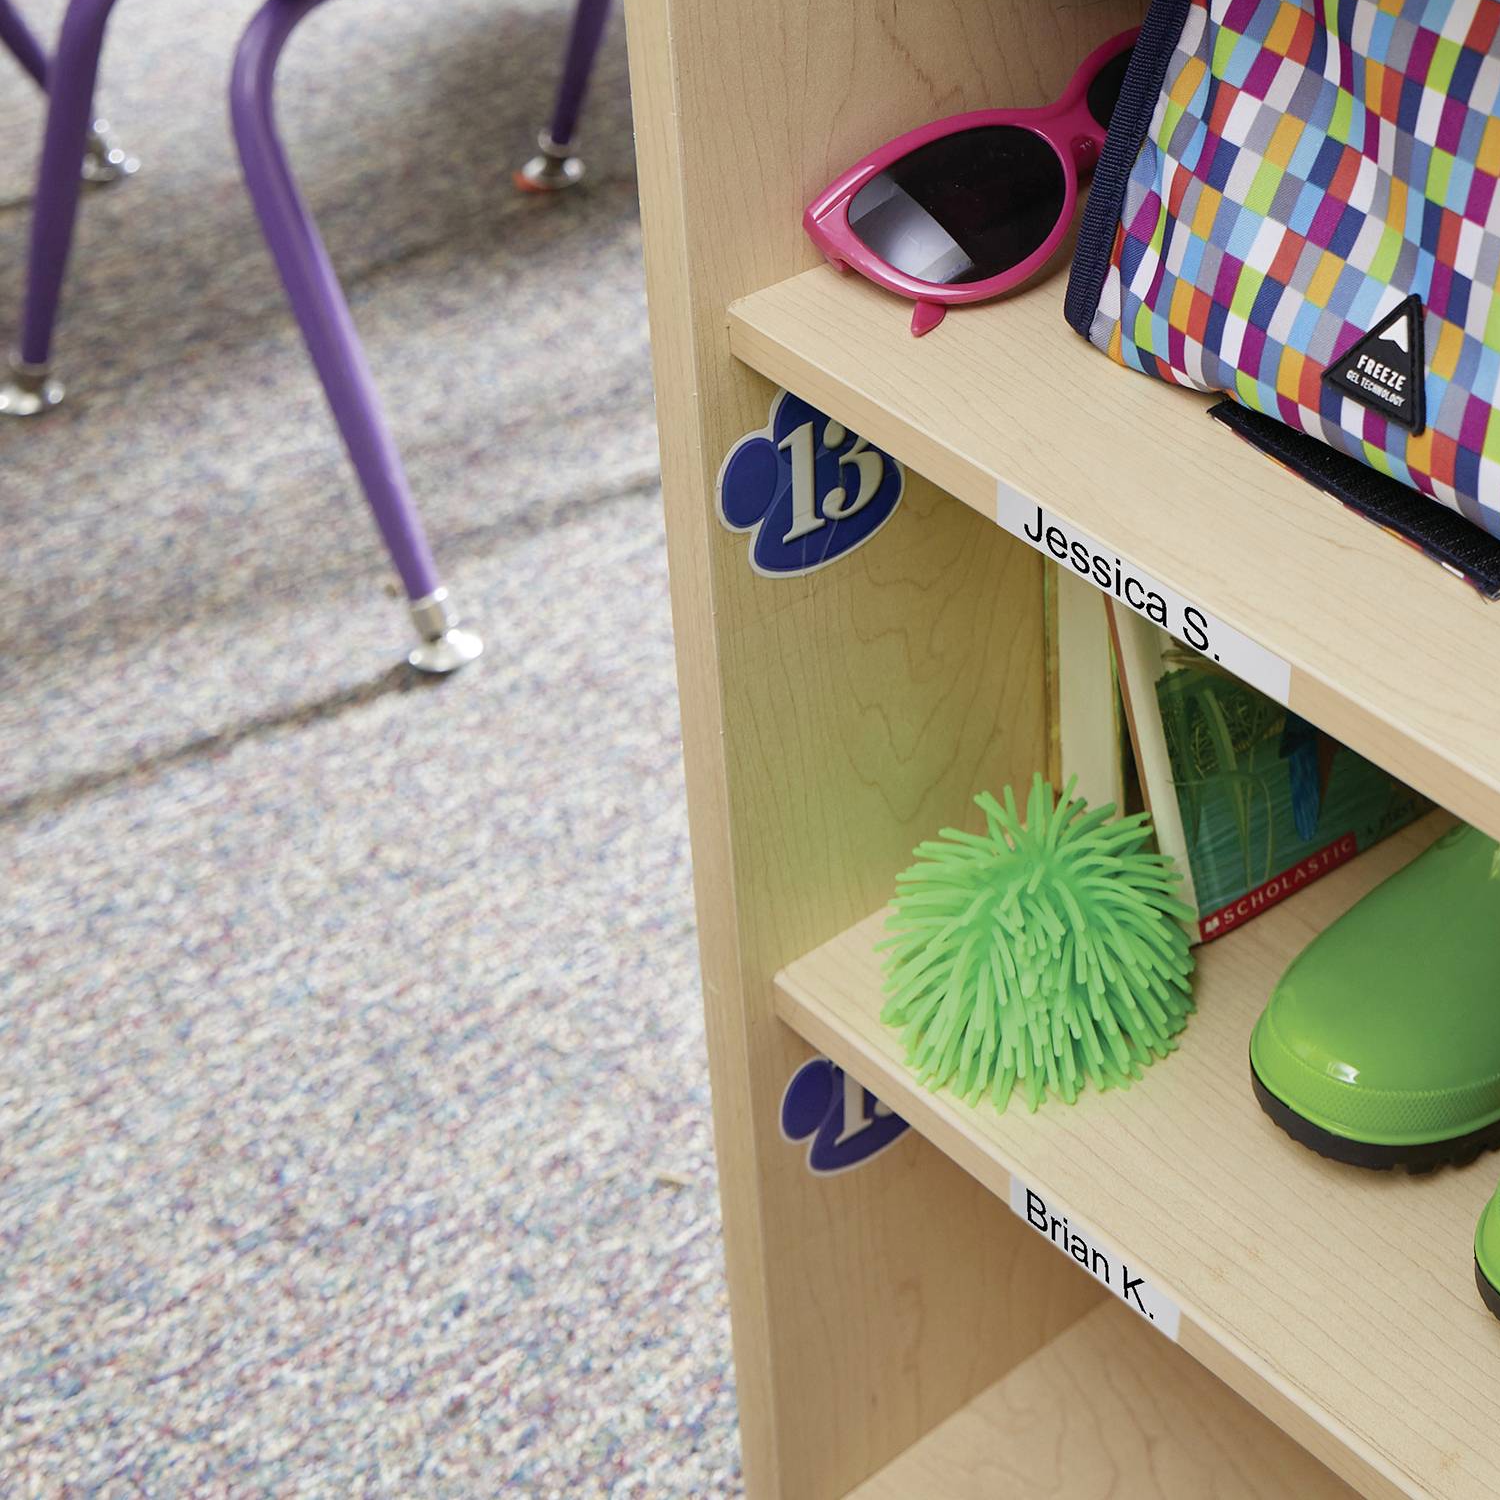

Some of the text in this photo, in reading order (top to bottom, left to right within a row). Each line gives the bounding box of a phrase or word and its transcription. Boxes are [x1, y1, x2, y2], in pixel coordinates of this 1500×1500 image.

[1346, 369, 1405, 407] GEL TECHNOLOGY
[1356, 354, 1407, 391] FREEZE
[777, 419, 884, 544] 13
[1023, 506, 1221, 662] Jessica S.
[1223, 838, 1352, 925] SCHOLASTIC
[1025, 1188, 1154, 1319] Brian K.
